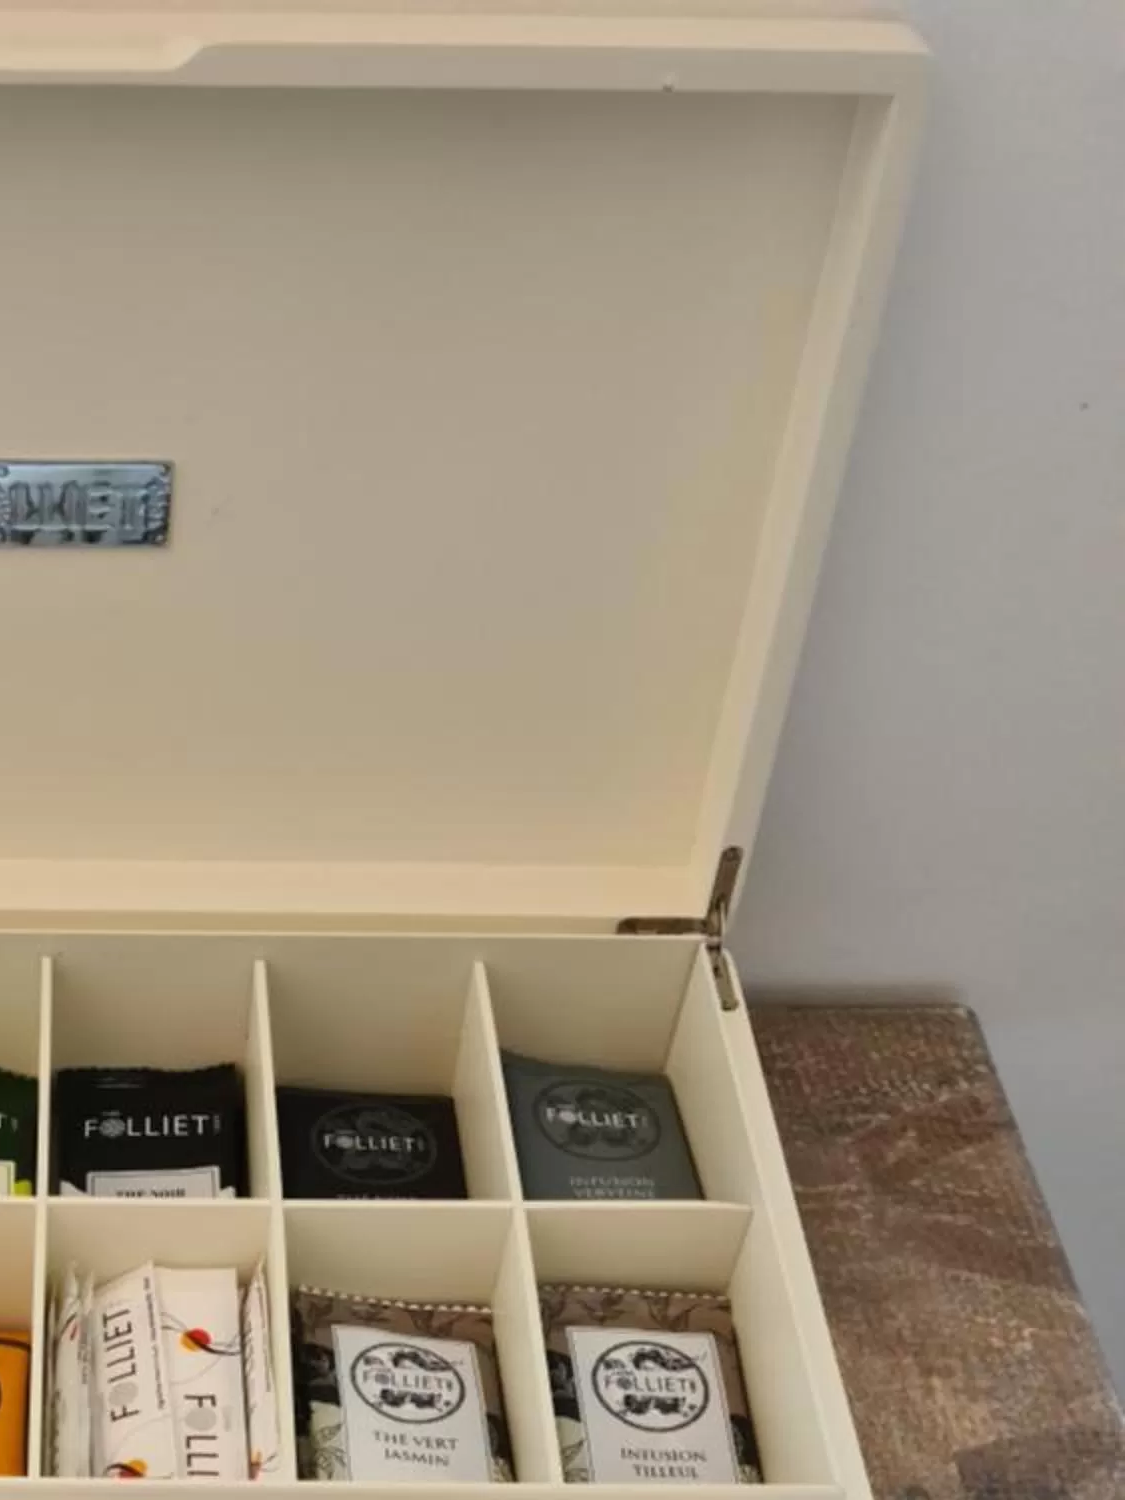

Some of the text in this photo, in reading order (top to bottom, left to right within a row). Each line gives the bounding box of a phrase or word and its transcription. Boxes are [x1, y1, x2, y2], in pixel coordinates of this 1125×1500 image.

[84, 1114, 210, 1138] FOLLIET
[102, 1307, 141, 1423] FOLLIET
[183, 1394, 220, 1478] FOLLI
